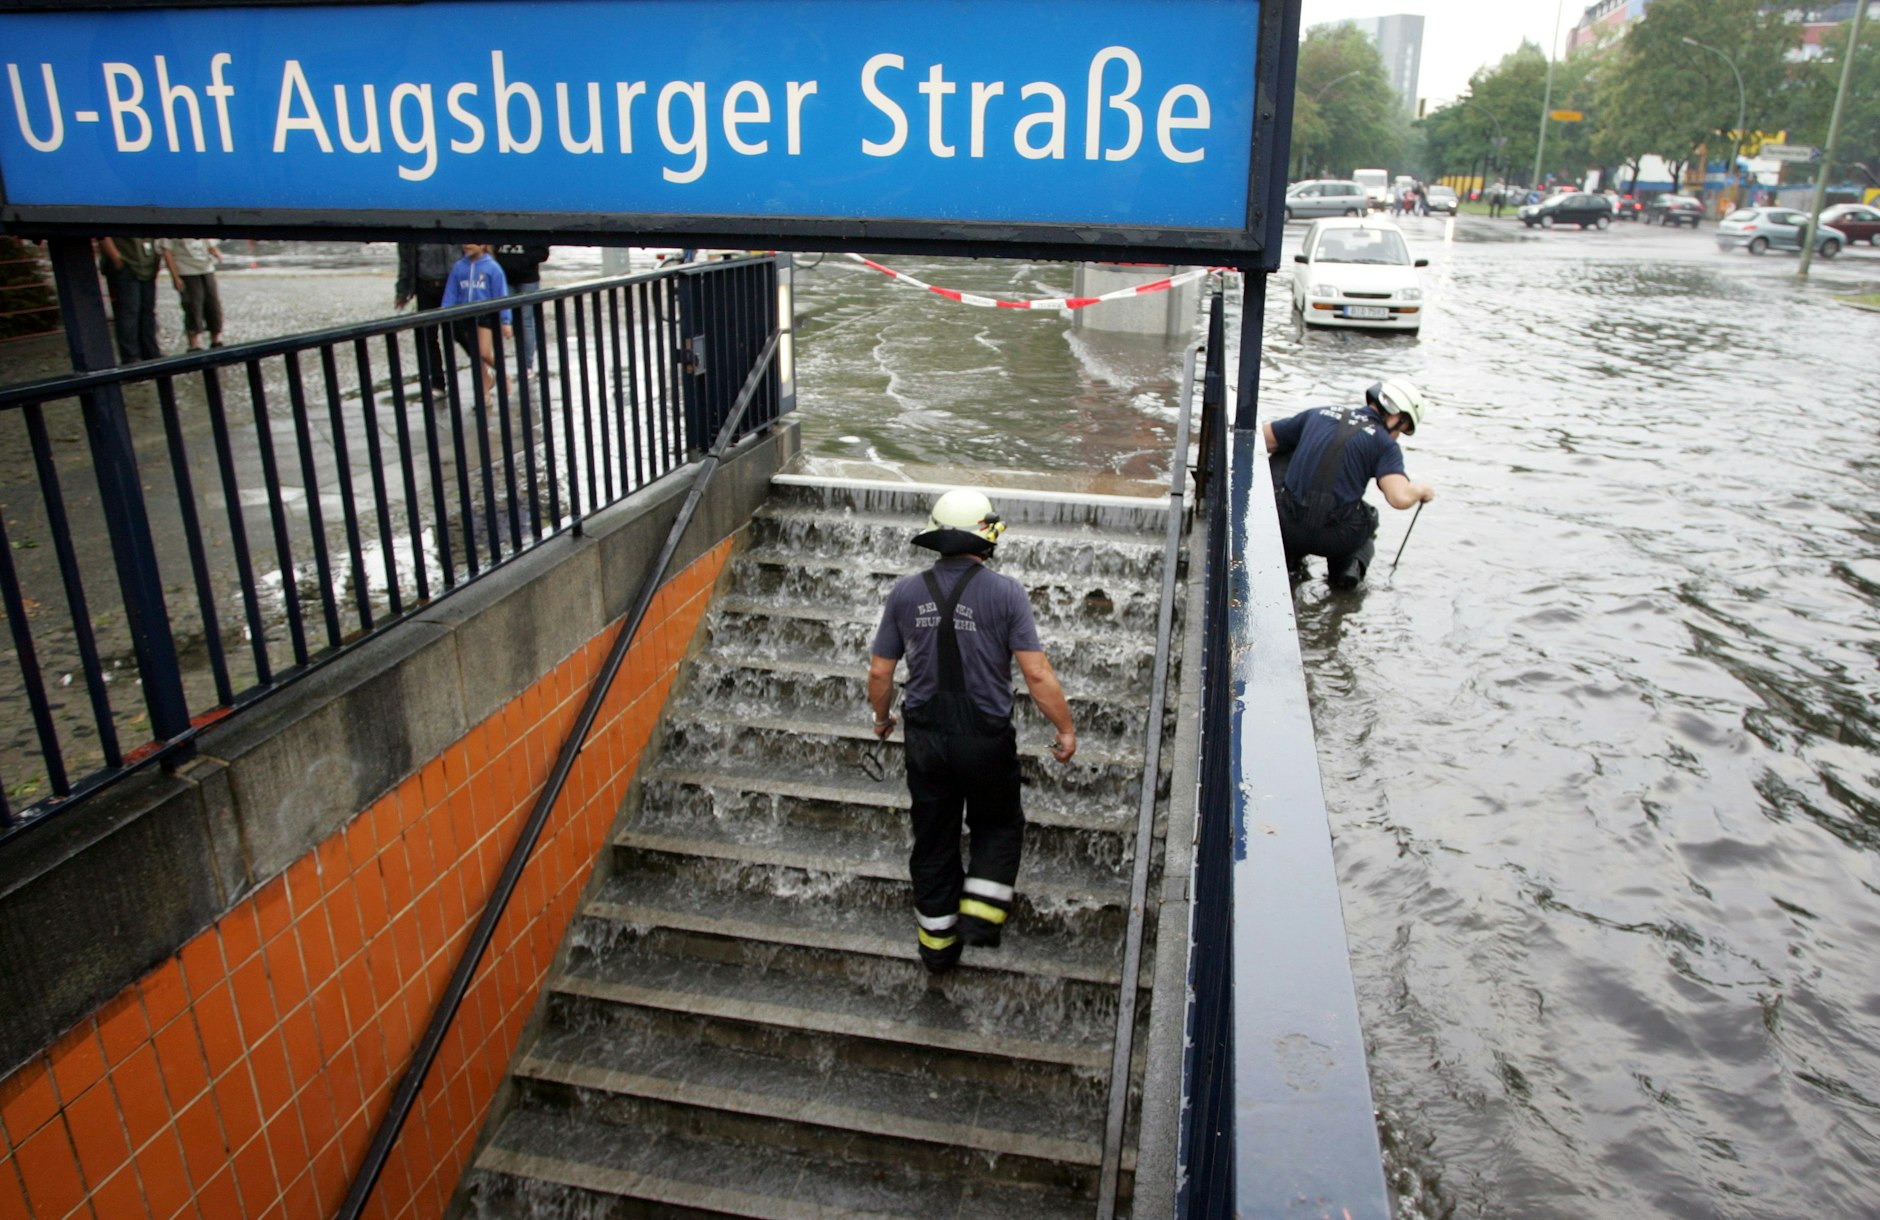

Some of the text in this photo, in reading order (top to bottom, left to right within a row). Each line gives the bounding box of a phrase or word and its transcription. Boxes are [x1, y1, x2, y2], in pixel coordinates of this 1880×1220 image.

[7, 45, 1211, 184] U-Bhf Augsburger Straße
